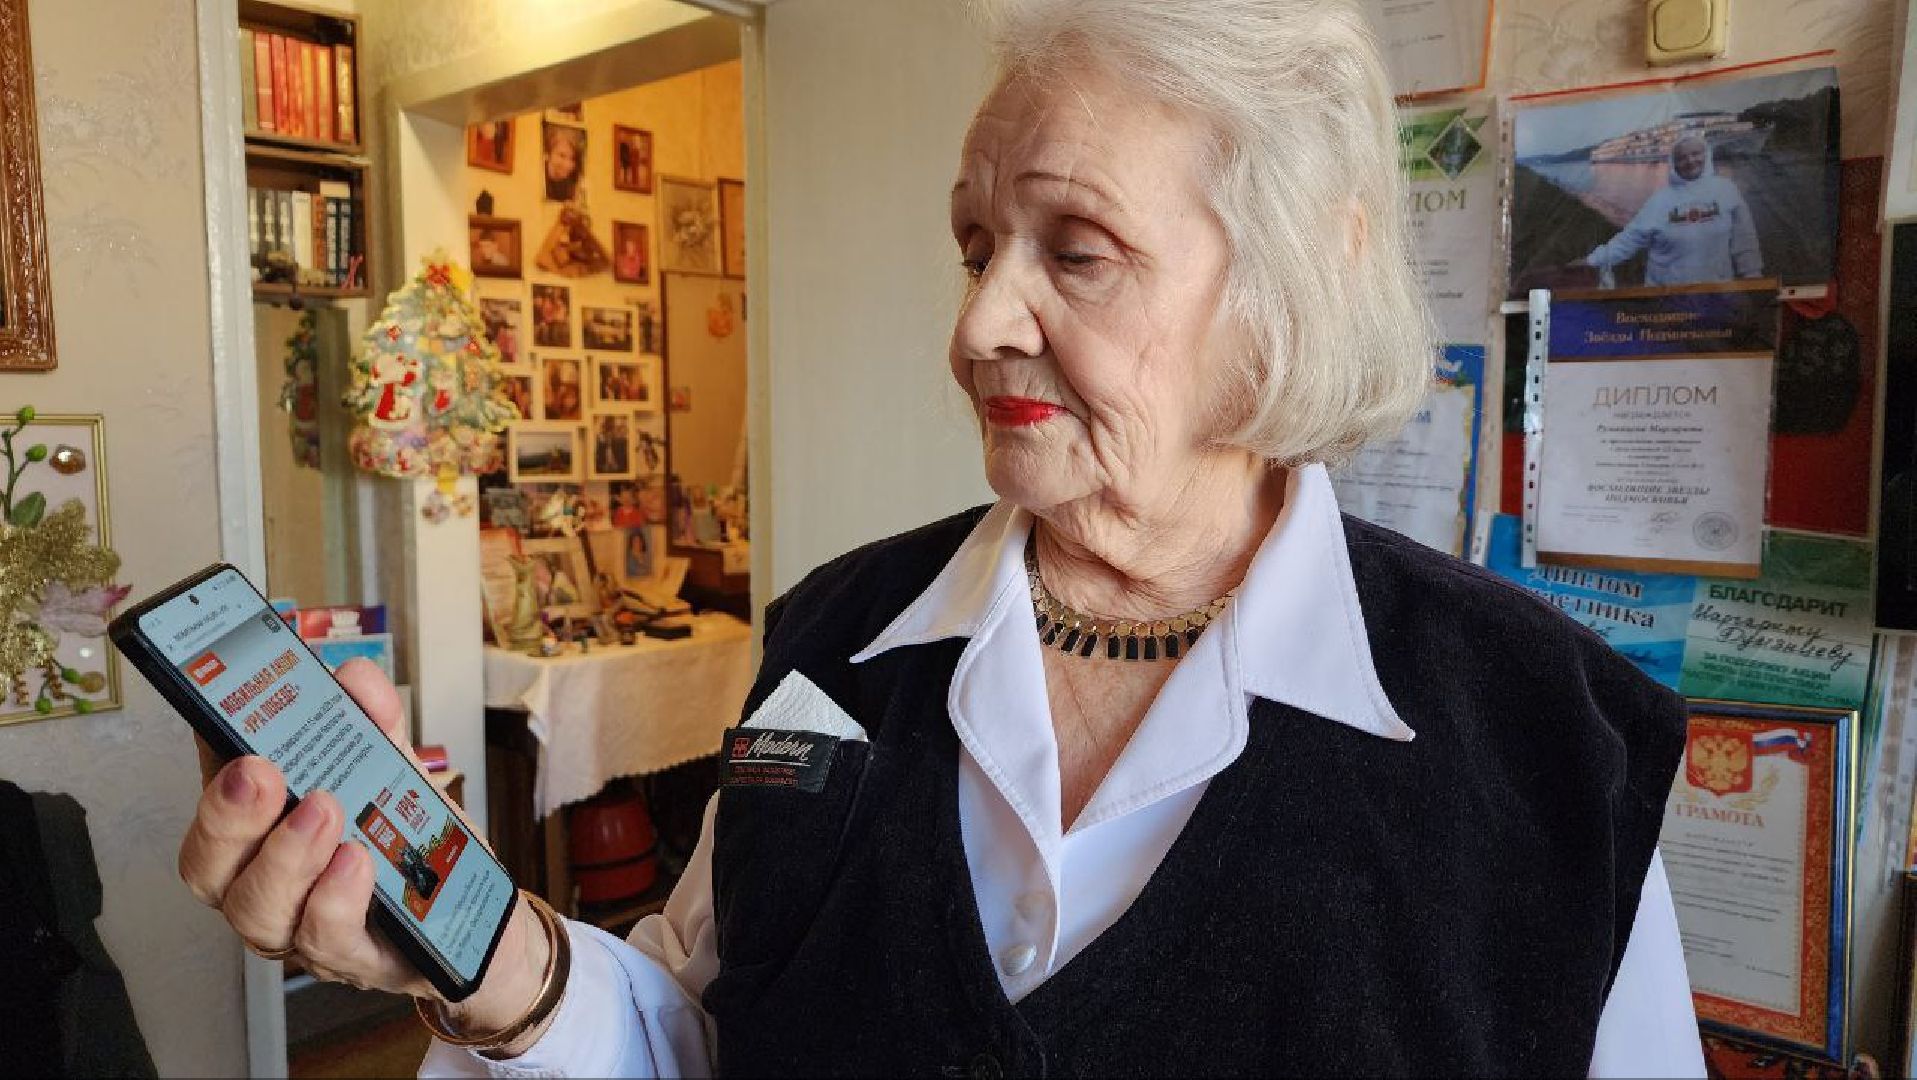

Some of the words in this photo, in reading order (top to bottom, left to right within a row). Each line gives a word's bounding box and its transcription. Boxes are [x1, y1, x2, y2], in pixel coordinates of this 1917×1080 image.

[1408, 188, 1466, 213] ЛОМ
[1593, 385, 1718, 408] ДИПЛОМ
[1709, 584, 1848, 618] БЛАГОДАРИТ
[1676, 803, 1765, 828] ГРАМОТА
